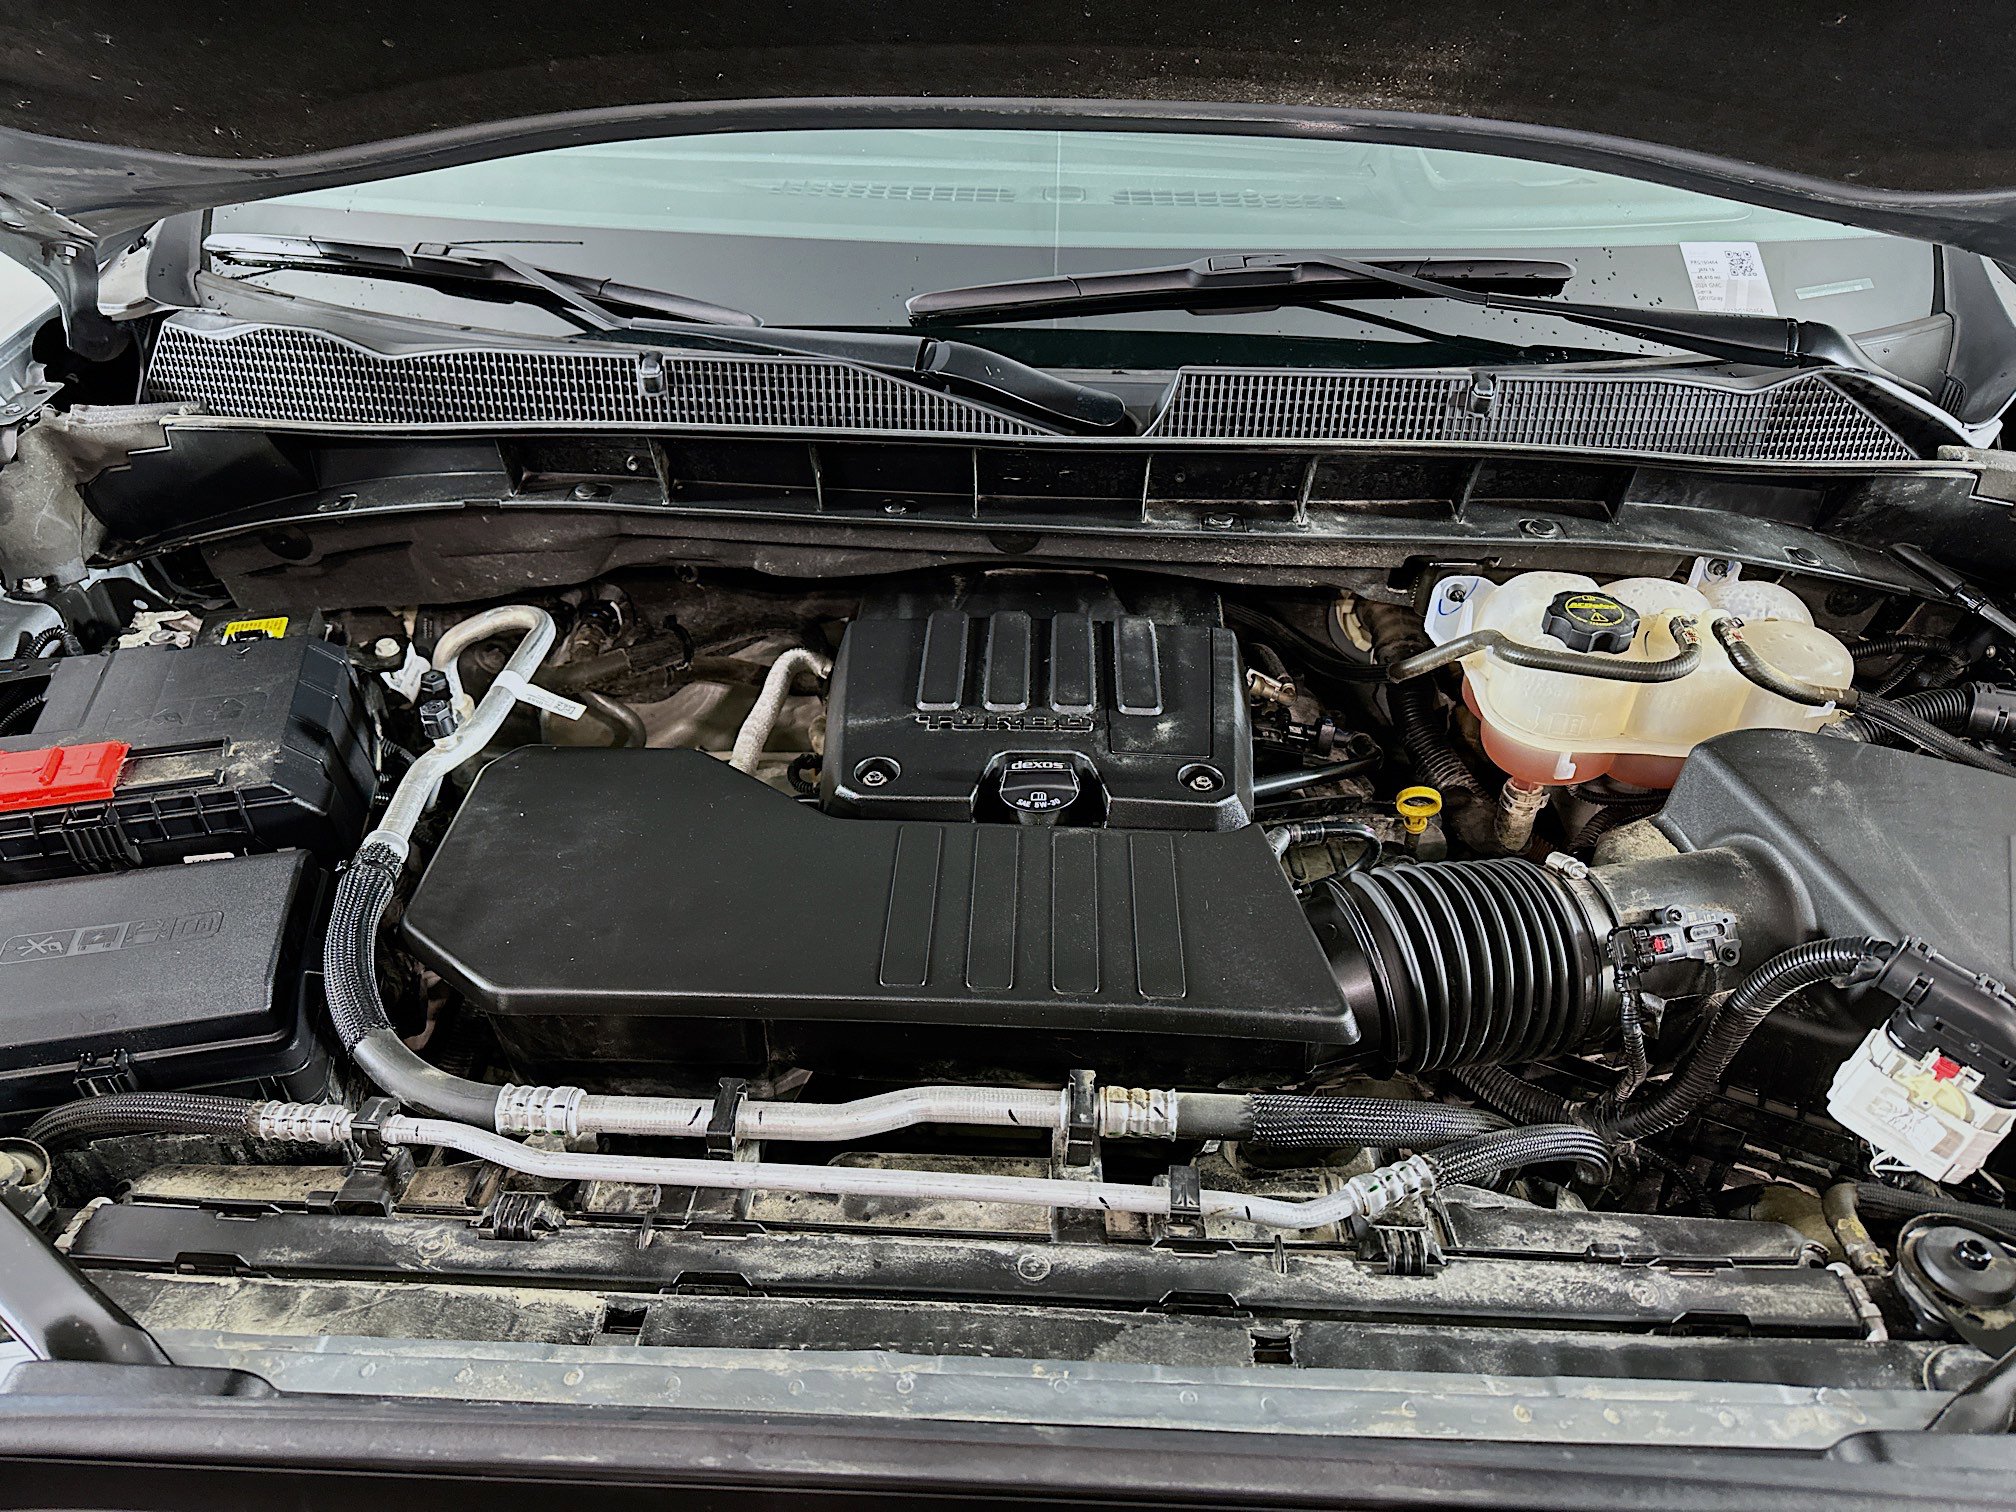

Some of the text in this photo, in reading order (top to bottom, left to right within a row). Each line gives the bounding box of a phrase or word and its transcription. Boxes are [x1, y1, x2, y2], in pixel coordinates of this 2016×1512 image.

[916, 714, 1094, 732] TURBO
[1011, 760, 1065, 770] dexos
[1016, 798, 1061, 808] SAE 5W-30
